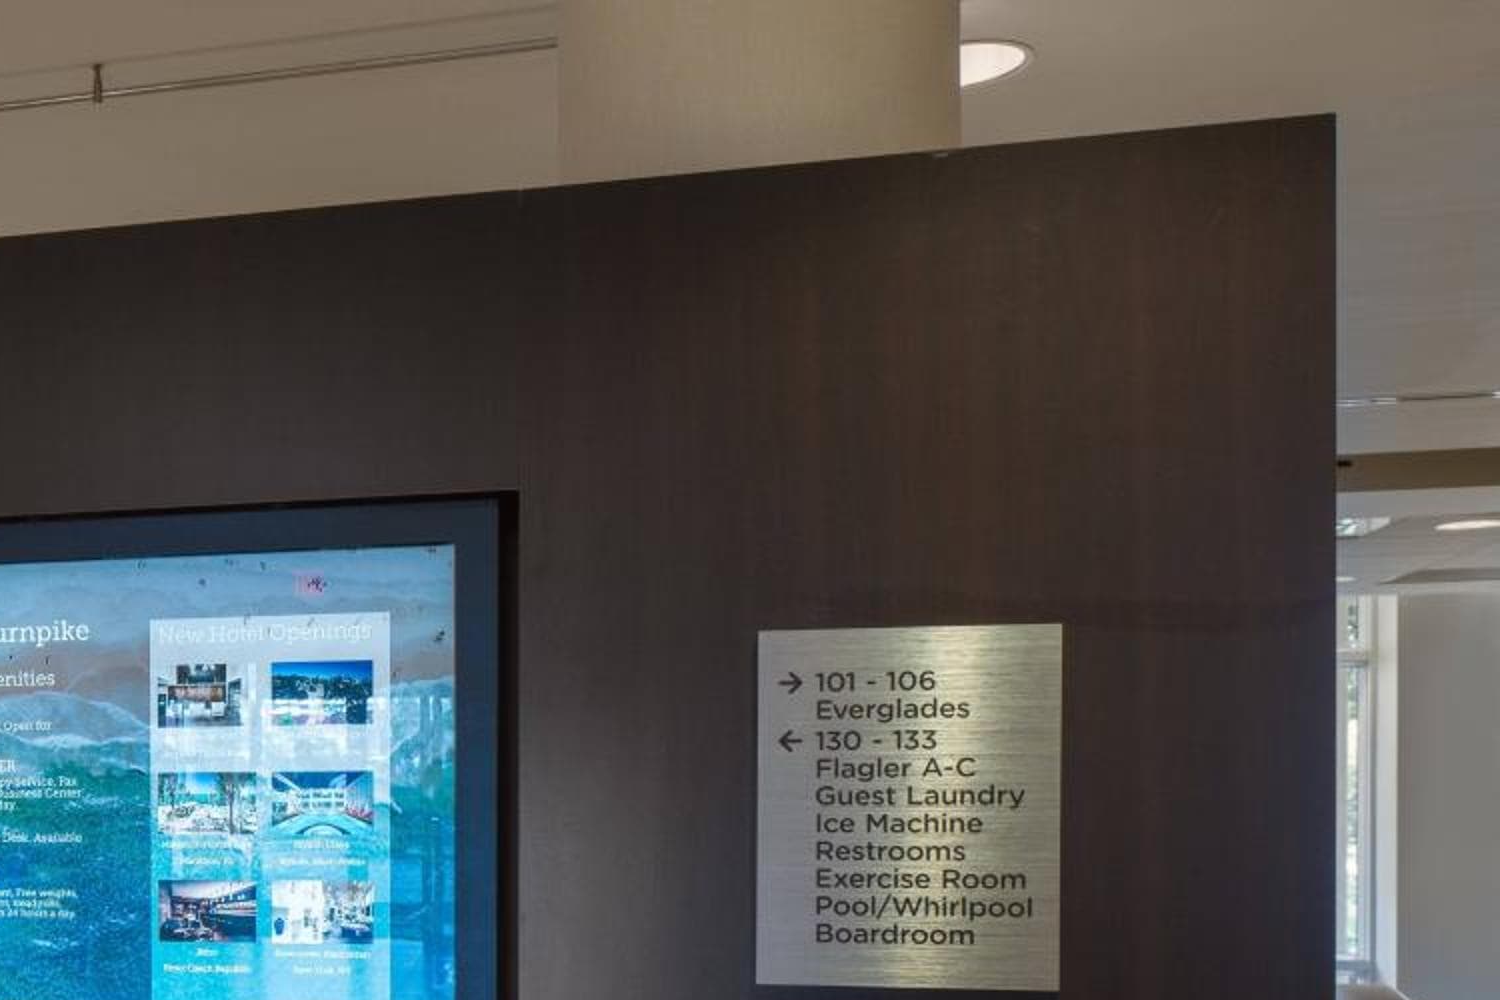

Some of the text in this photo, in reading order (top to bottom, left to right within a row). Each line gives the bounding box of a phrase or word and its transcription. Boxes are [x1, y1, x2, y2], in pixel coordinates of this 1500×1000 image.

[159, 626, 203, 643] New
[270, 623, 373, 644] Openings
[815, 672, 856, 693] 101
[888, 671, 936, 692] 106
[815, 698, 971, 723] Everglades
[815, 731, 862, 751] 130
[894, 730, 938, 750] 133
[815, 757, 977, 782] Flagler A-C
[815, 784, 1026, 811] Guest Laundry
[815, 813, 984, 834] Ice Machine
[815, 841, 967, 862] Restrooms
[815, 868, 1028, 889] Exercise Room
[815, 894, 1033, 921] Pool/Whirlpool
[815, 923, 977, 945] Boardroom
